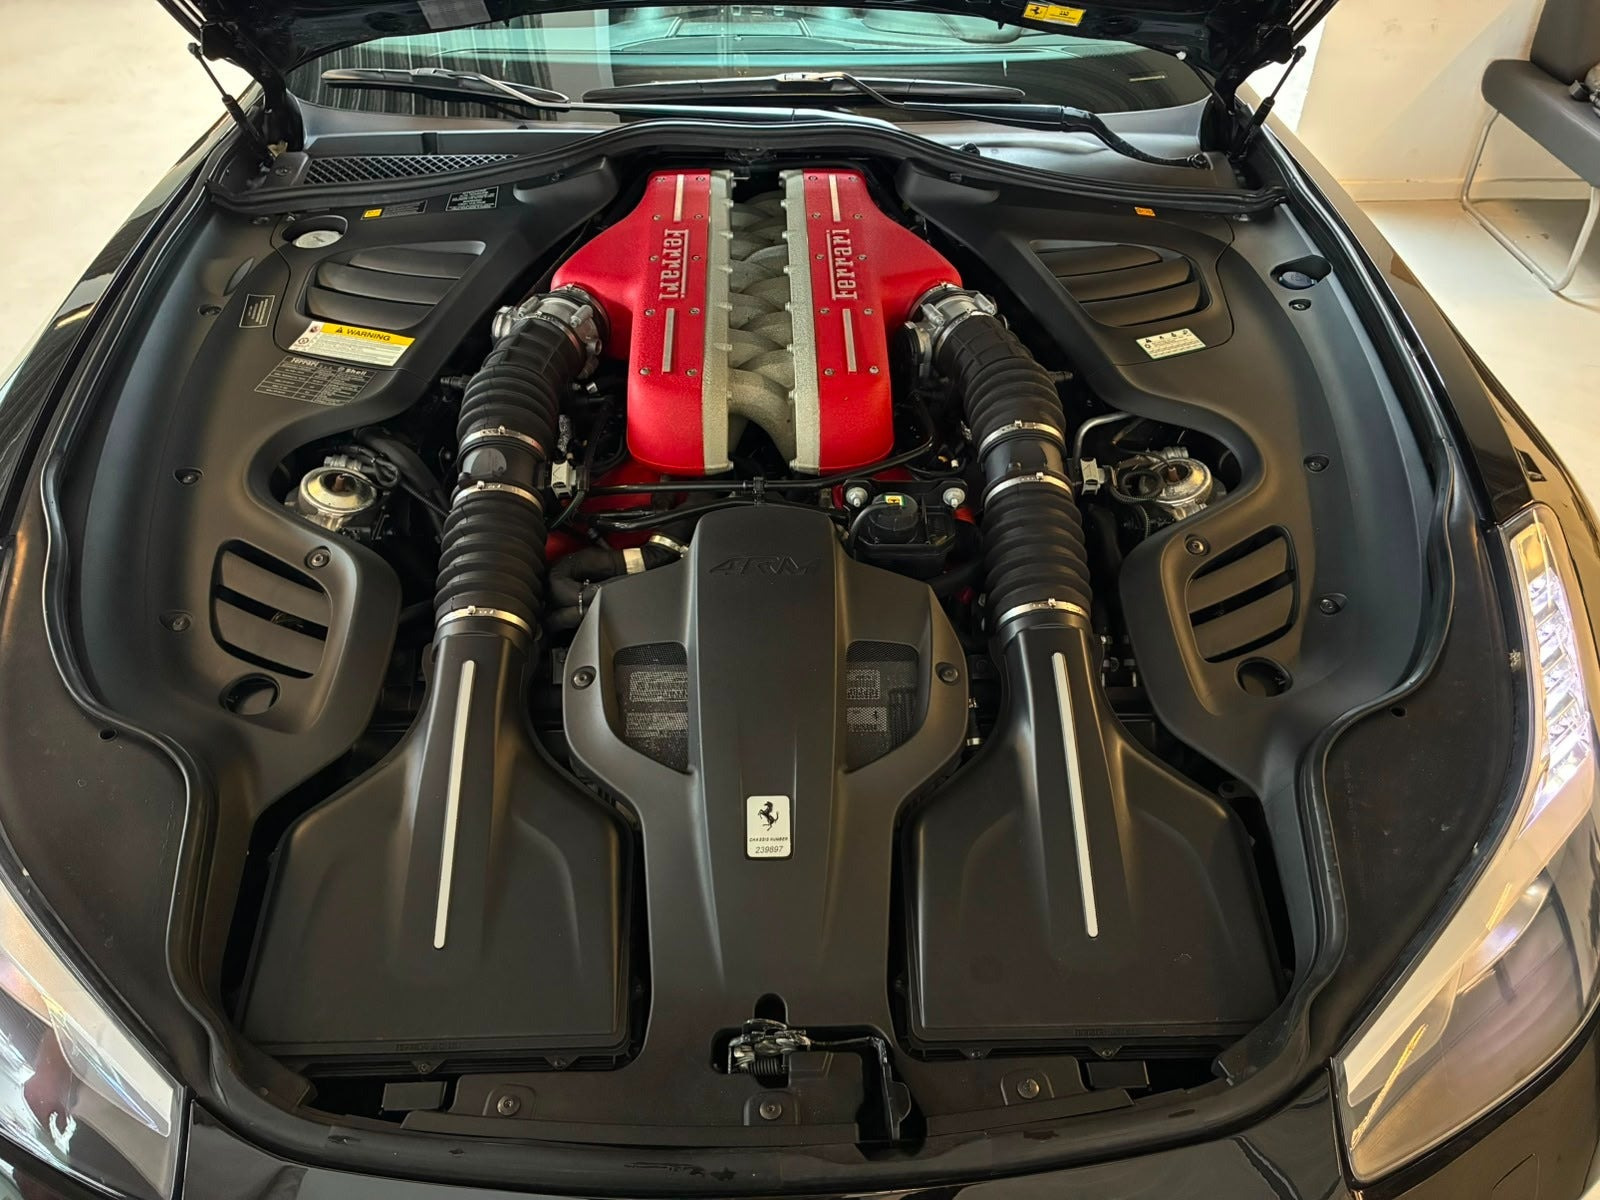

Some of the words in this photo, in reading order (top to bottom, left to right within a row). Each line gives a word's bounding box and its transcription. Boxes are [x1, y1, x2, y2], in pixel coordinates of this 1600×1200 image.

[658, 228, 689, 301] Ferrari
[825, 228, 858, 301] Ferrari
[346, 328, 391, 341] WARNING
[345, 368, 367, 376] Shell
[755, 845, 784, 854] 239897
